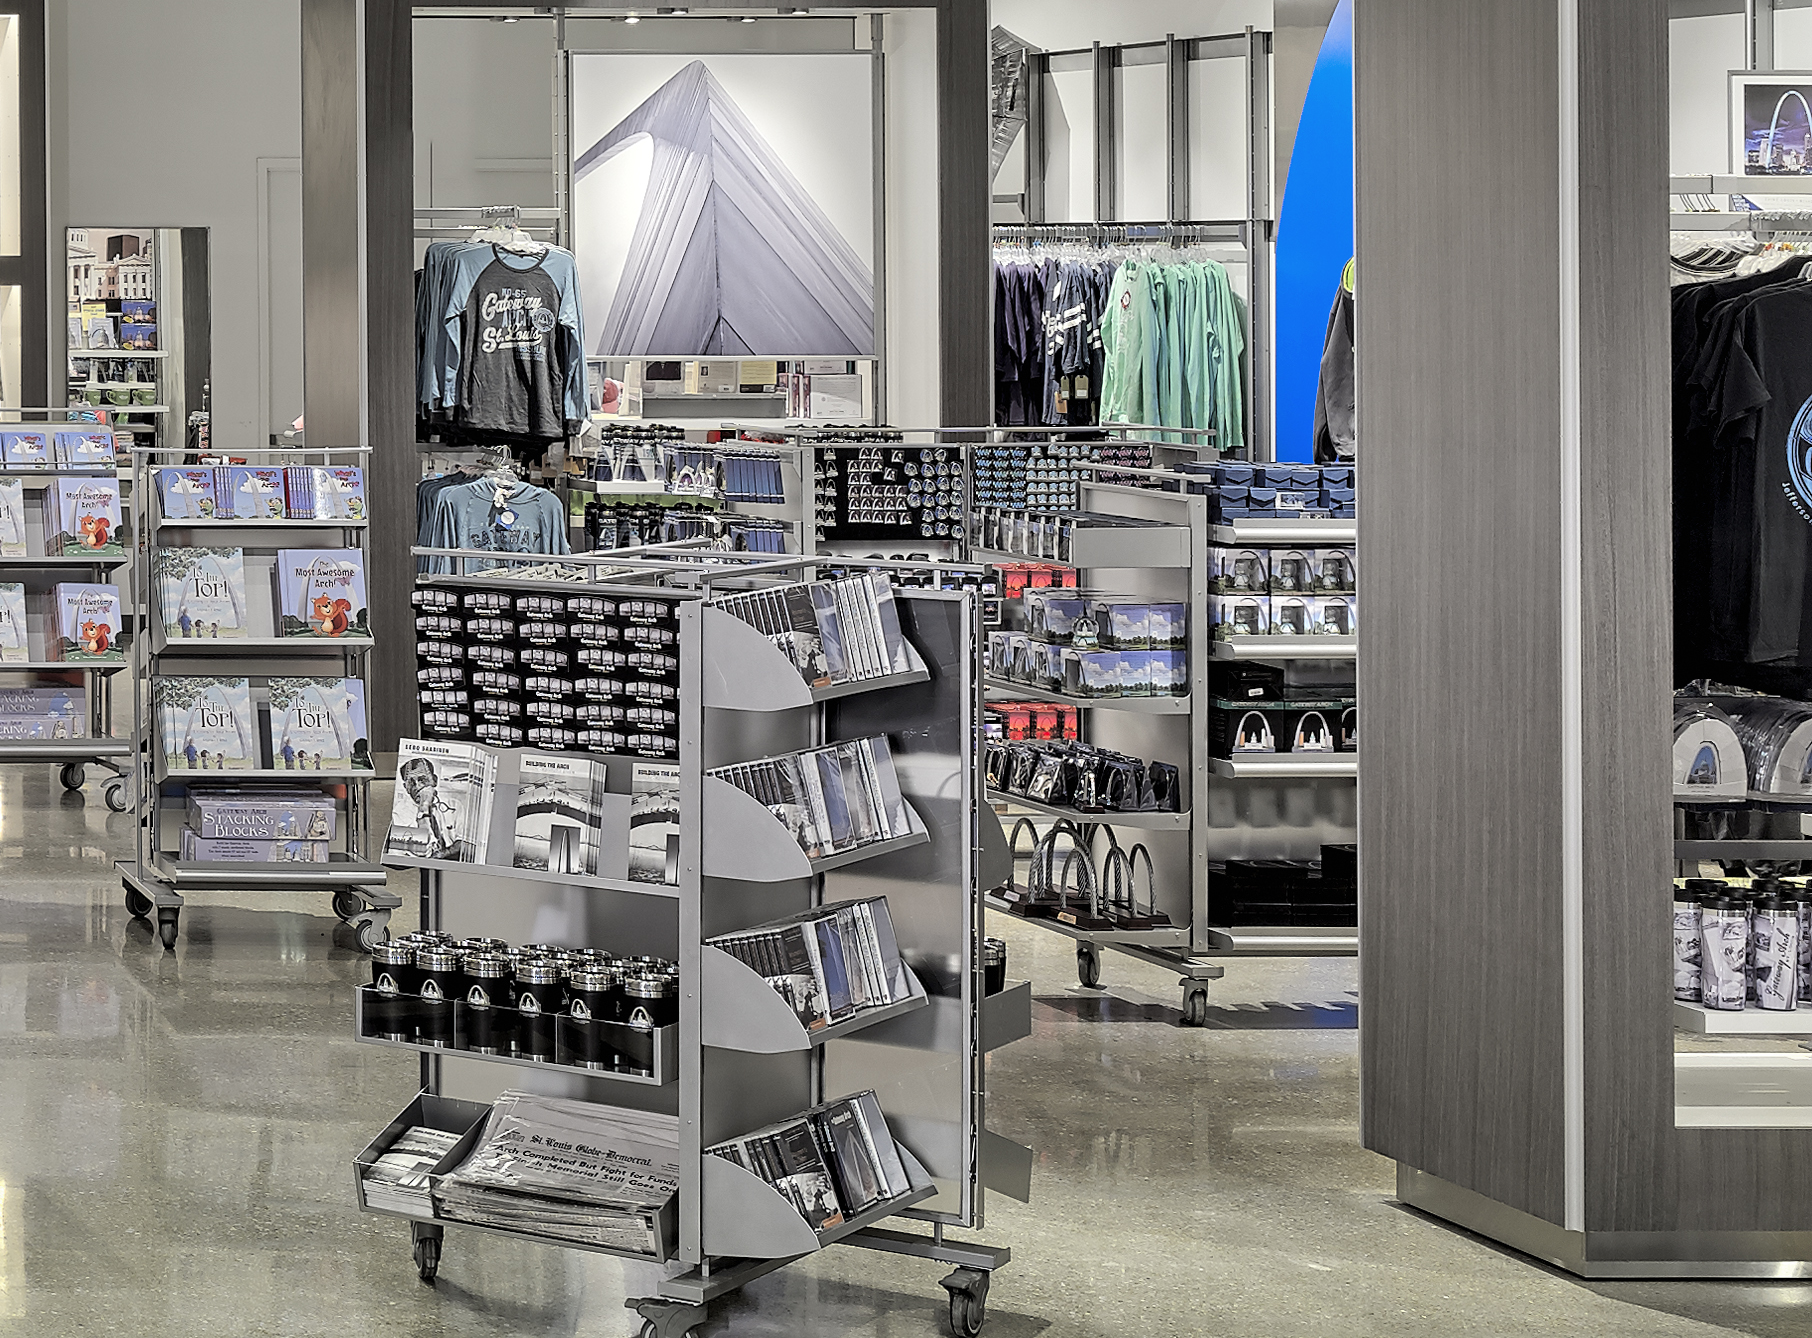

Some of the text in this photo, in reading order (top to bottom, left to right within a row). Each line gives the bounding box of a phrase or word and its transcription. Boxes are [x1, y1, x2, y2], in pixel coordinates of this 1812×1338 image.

[482, 292, 542, 321] Gateway
[482, 324, 542, 353] St. Louis
[295, 567, 354, 577] Most Awesome
[203, 812, 274, 825] STACKING
[214, 825, 269, 837] BLOCKS
[544, 1137, 572, 1152] Louis
[494, 1144, 520, 1155] Arch
[522, 1149, 577, 1166] Completed
[579, 1160, 599, 1170] But
[600, 1164, 626, 1177] Fight
[629, 1170, 645, 1180] for
[547, 1161, 655, 1189] Memorial Still Goes
